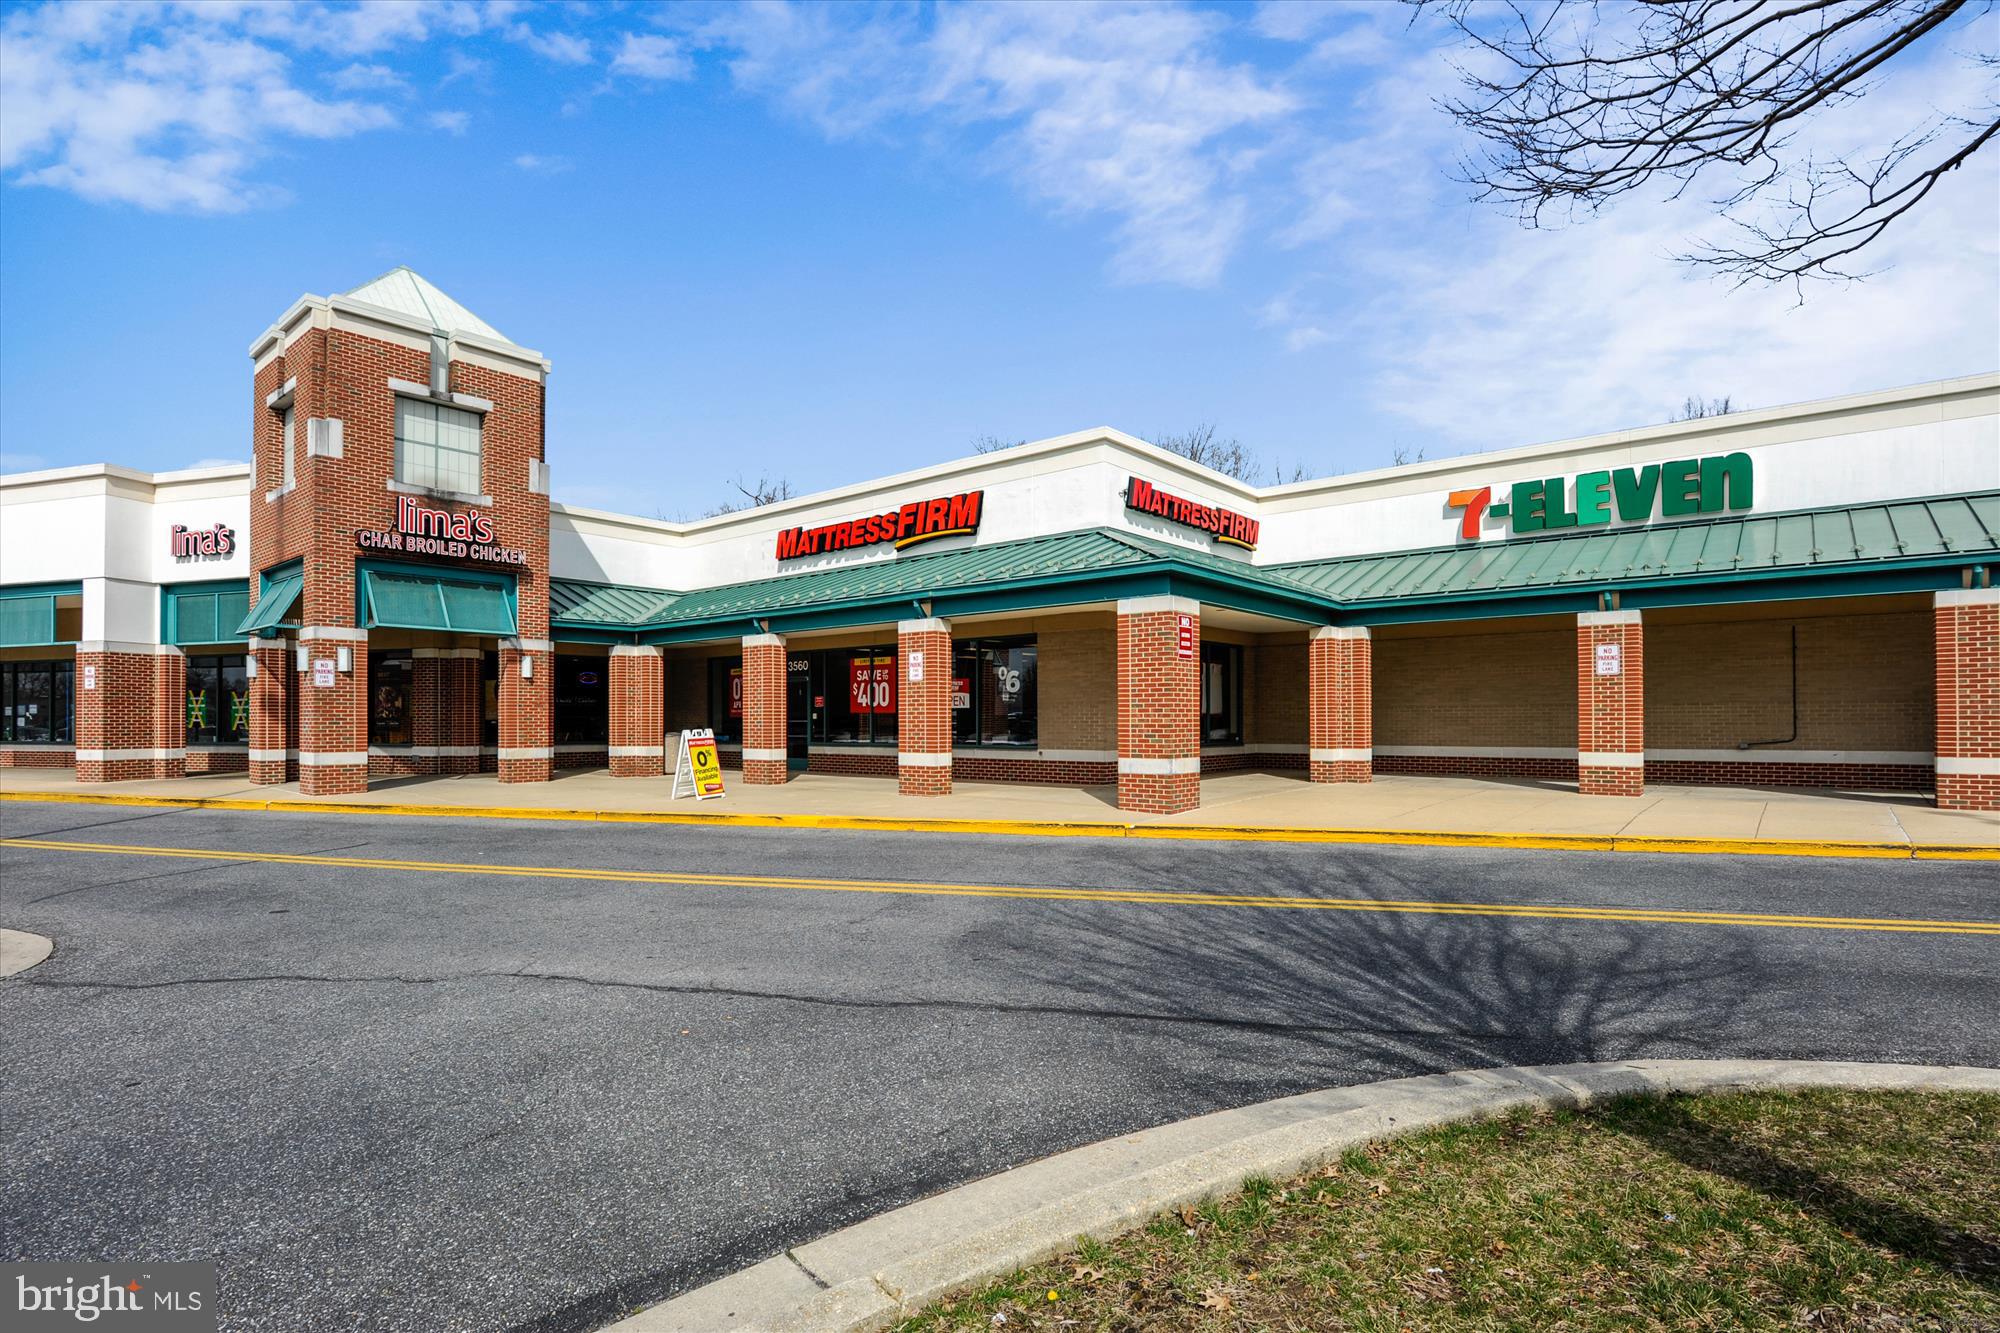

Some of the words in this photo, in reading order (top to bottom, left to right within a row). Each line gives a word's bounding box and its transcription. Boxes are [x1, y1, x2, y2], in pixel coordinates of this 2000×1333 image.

[398, 496, 493, 543] lima's
[171, 523, 230, 557] lima's
[360, 530, 402, 550] CHAR
[406, 536, 467, 558] BROILED
[470, 544, 527, 565] CHICKEN
[788, 660, 809, 672] 3560
[856, 670, 882, 681] SAVE
[853, 682, 890, 707] $400
[695, 766, 718, 775] Financing
